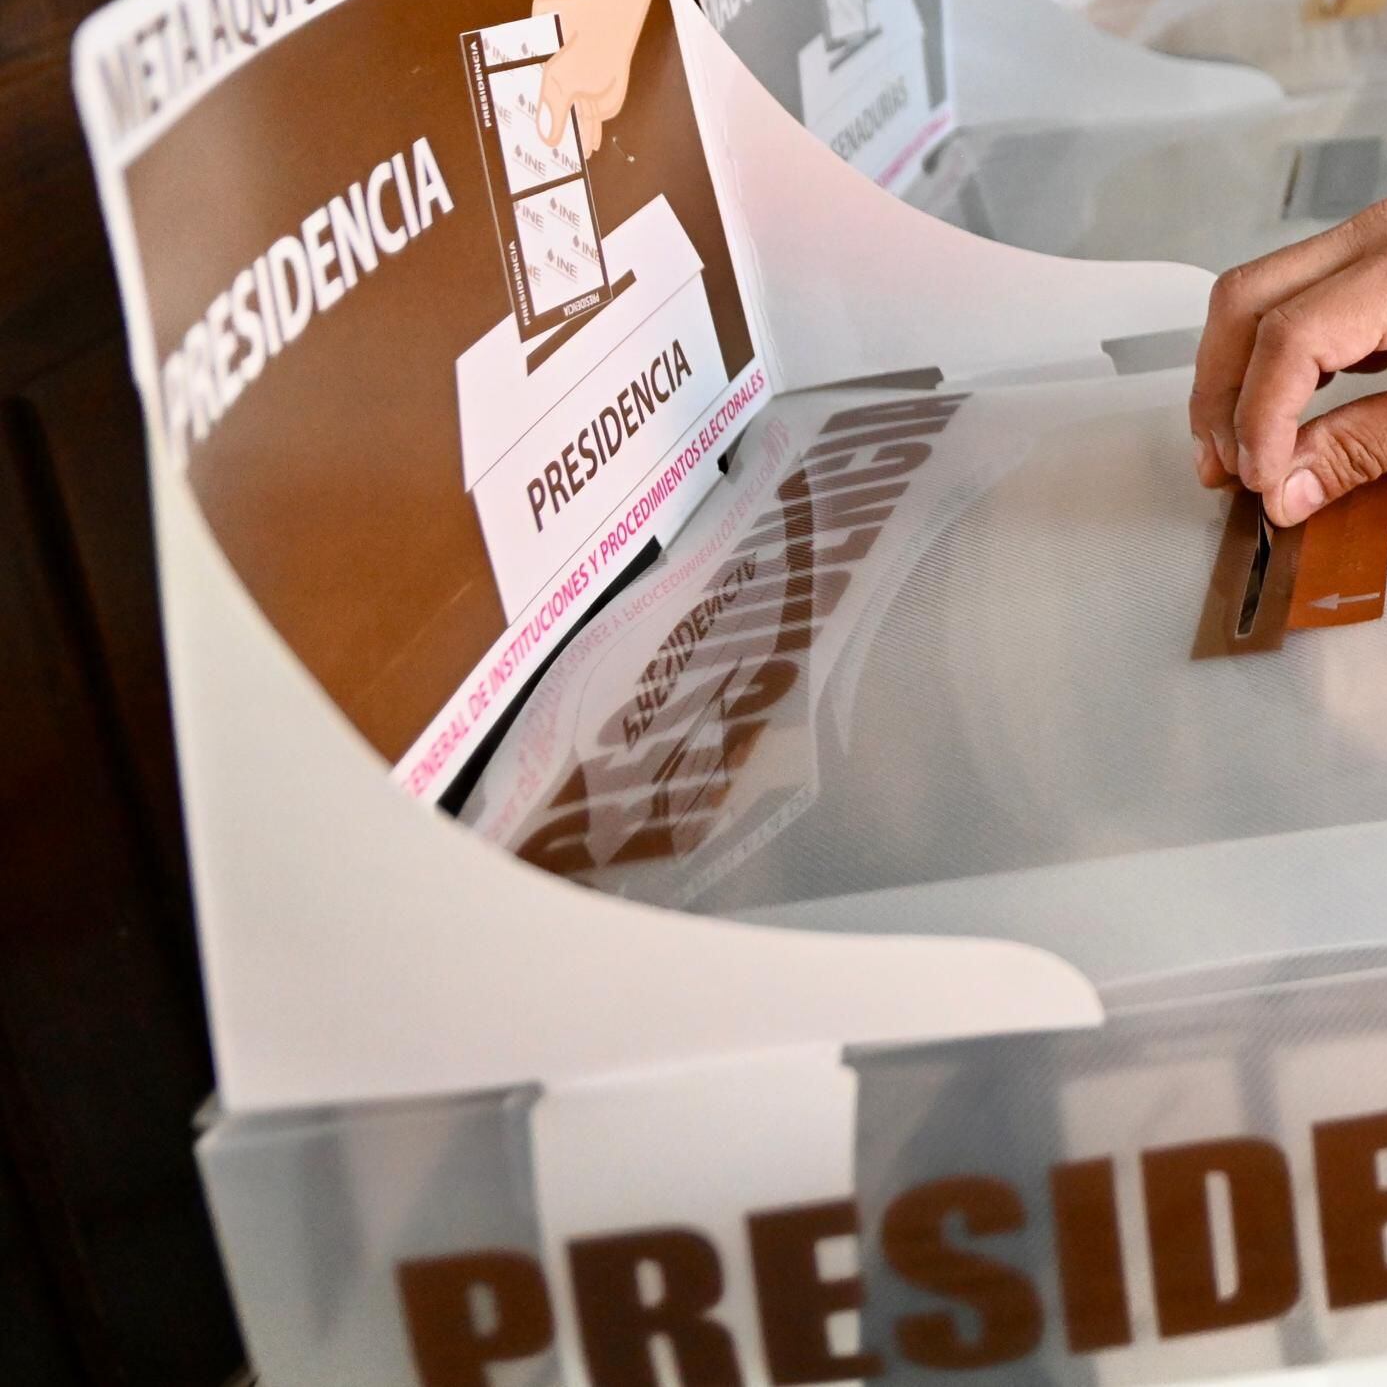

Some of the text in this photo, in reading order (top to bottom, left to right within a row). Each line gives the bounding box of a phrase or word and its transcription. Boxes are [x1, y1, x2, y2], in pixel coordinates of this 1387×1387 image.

[97, 0, 202, 146] META
[470, 40, 493, 128] PRESIDENCIA
[524, 152, 547, 175] INE
[522, 204, 545, 229] INE
[559, 203, 581, 228] INE
[162, 136, 455, 454] PRESIDENCIA
[508, 240, 531, 327] PRESIDENCIA
[556, 255, 578, 279] INE
[527, 339, 692, 533] PRESIDENCIA
[402, 368, 766, 799] ENERAL DE INSTITUCIONES Y PROCEDIMIENTOS ELECTORALES
